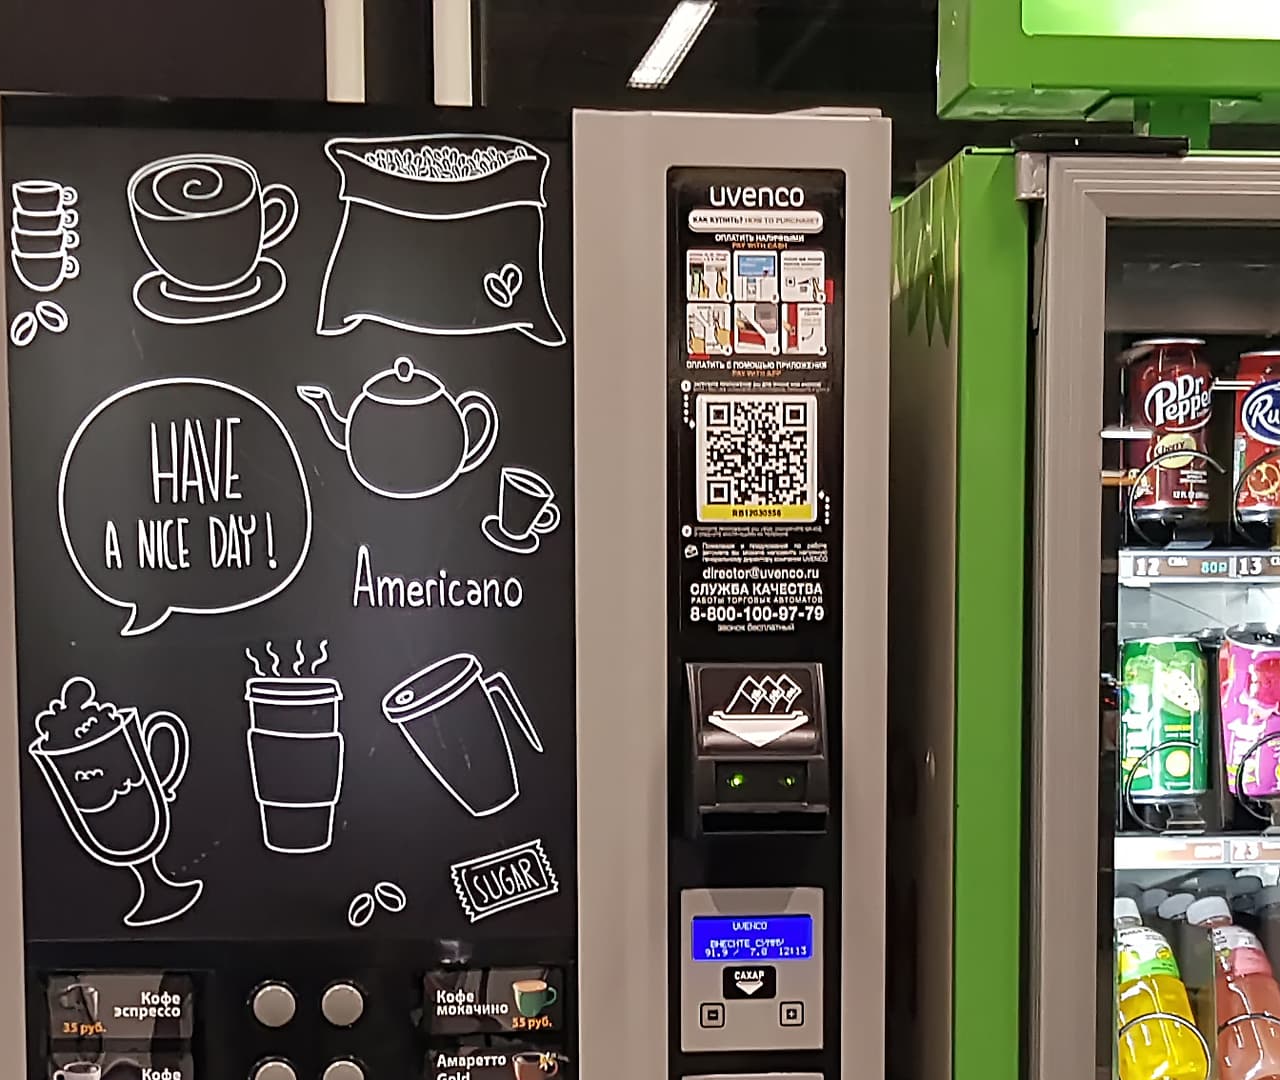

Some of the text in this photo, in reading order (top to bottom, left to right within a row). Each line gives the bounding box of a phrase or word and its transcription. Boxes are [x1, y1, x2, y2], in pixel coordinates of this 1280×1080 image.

[709, 185, 805, 208] uvenco
[1177, 374, 1204, 394] Dr
[150, 417, 243, 505] HAVE
[104, 520, 123, 570] A
[138, 516, 190, 570] NICE
[1136, 557, 1160, 576] 12
[1239, 557, 1263, 575] 13
[353, 544, 523, 609] Americano
[690, 583, 823, 596] СЛУЖБА КАЧЕСТВА
[690, 606, 825, 621] 8-800-100-97-79
[473, 857, 540, 905] SUGAR
[734, 970, 765, 981] САХАР
[141, 990, 181, 1008] Кофе
[436, 989, 474, 1006] Кофе
[113, 1006, 181, 1021] эспрессо
[436, 1002, 509, 1016] мокачино
[63, 1022, 78, 1034] 35
[436, 1053, 507, 1069] Амаретто
